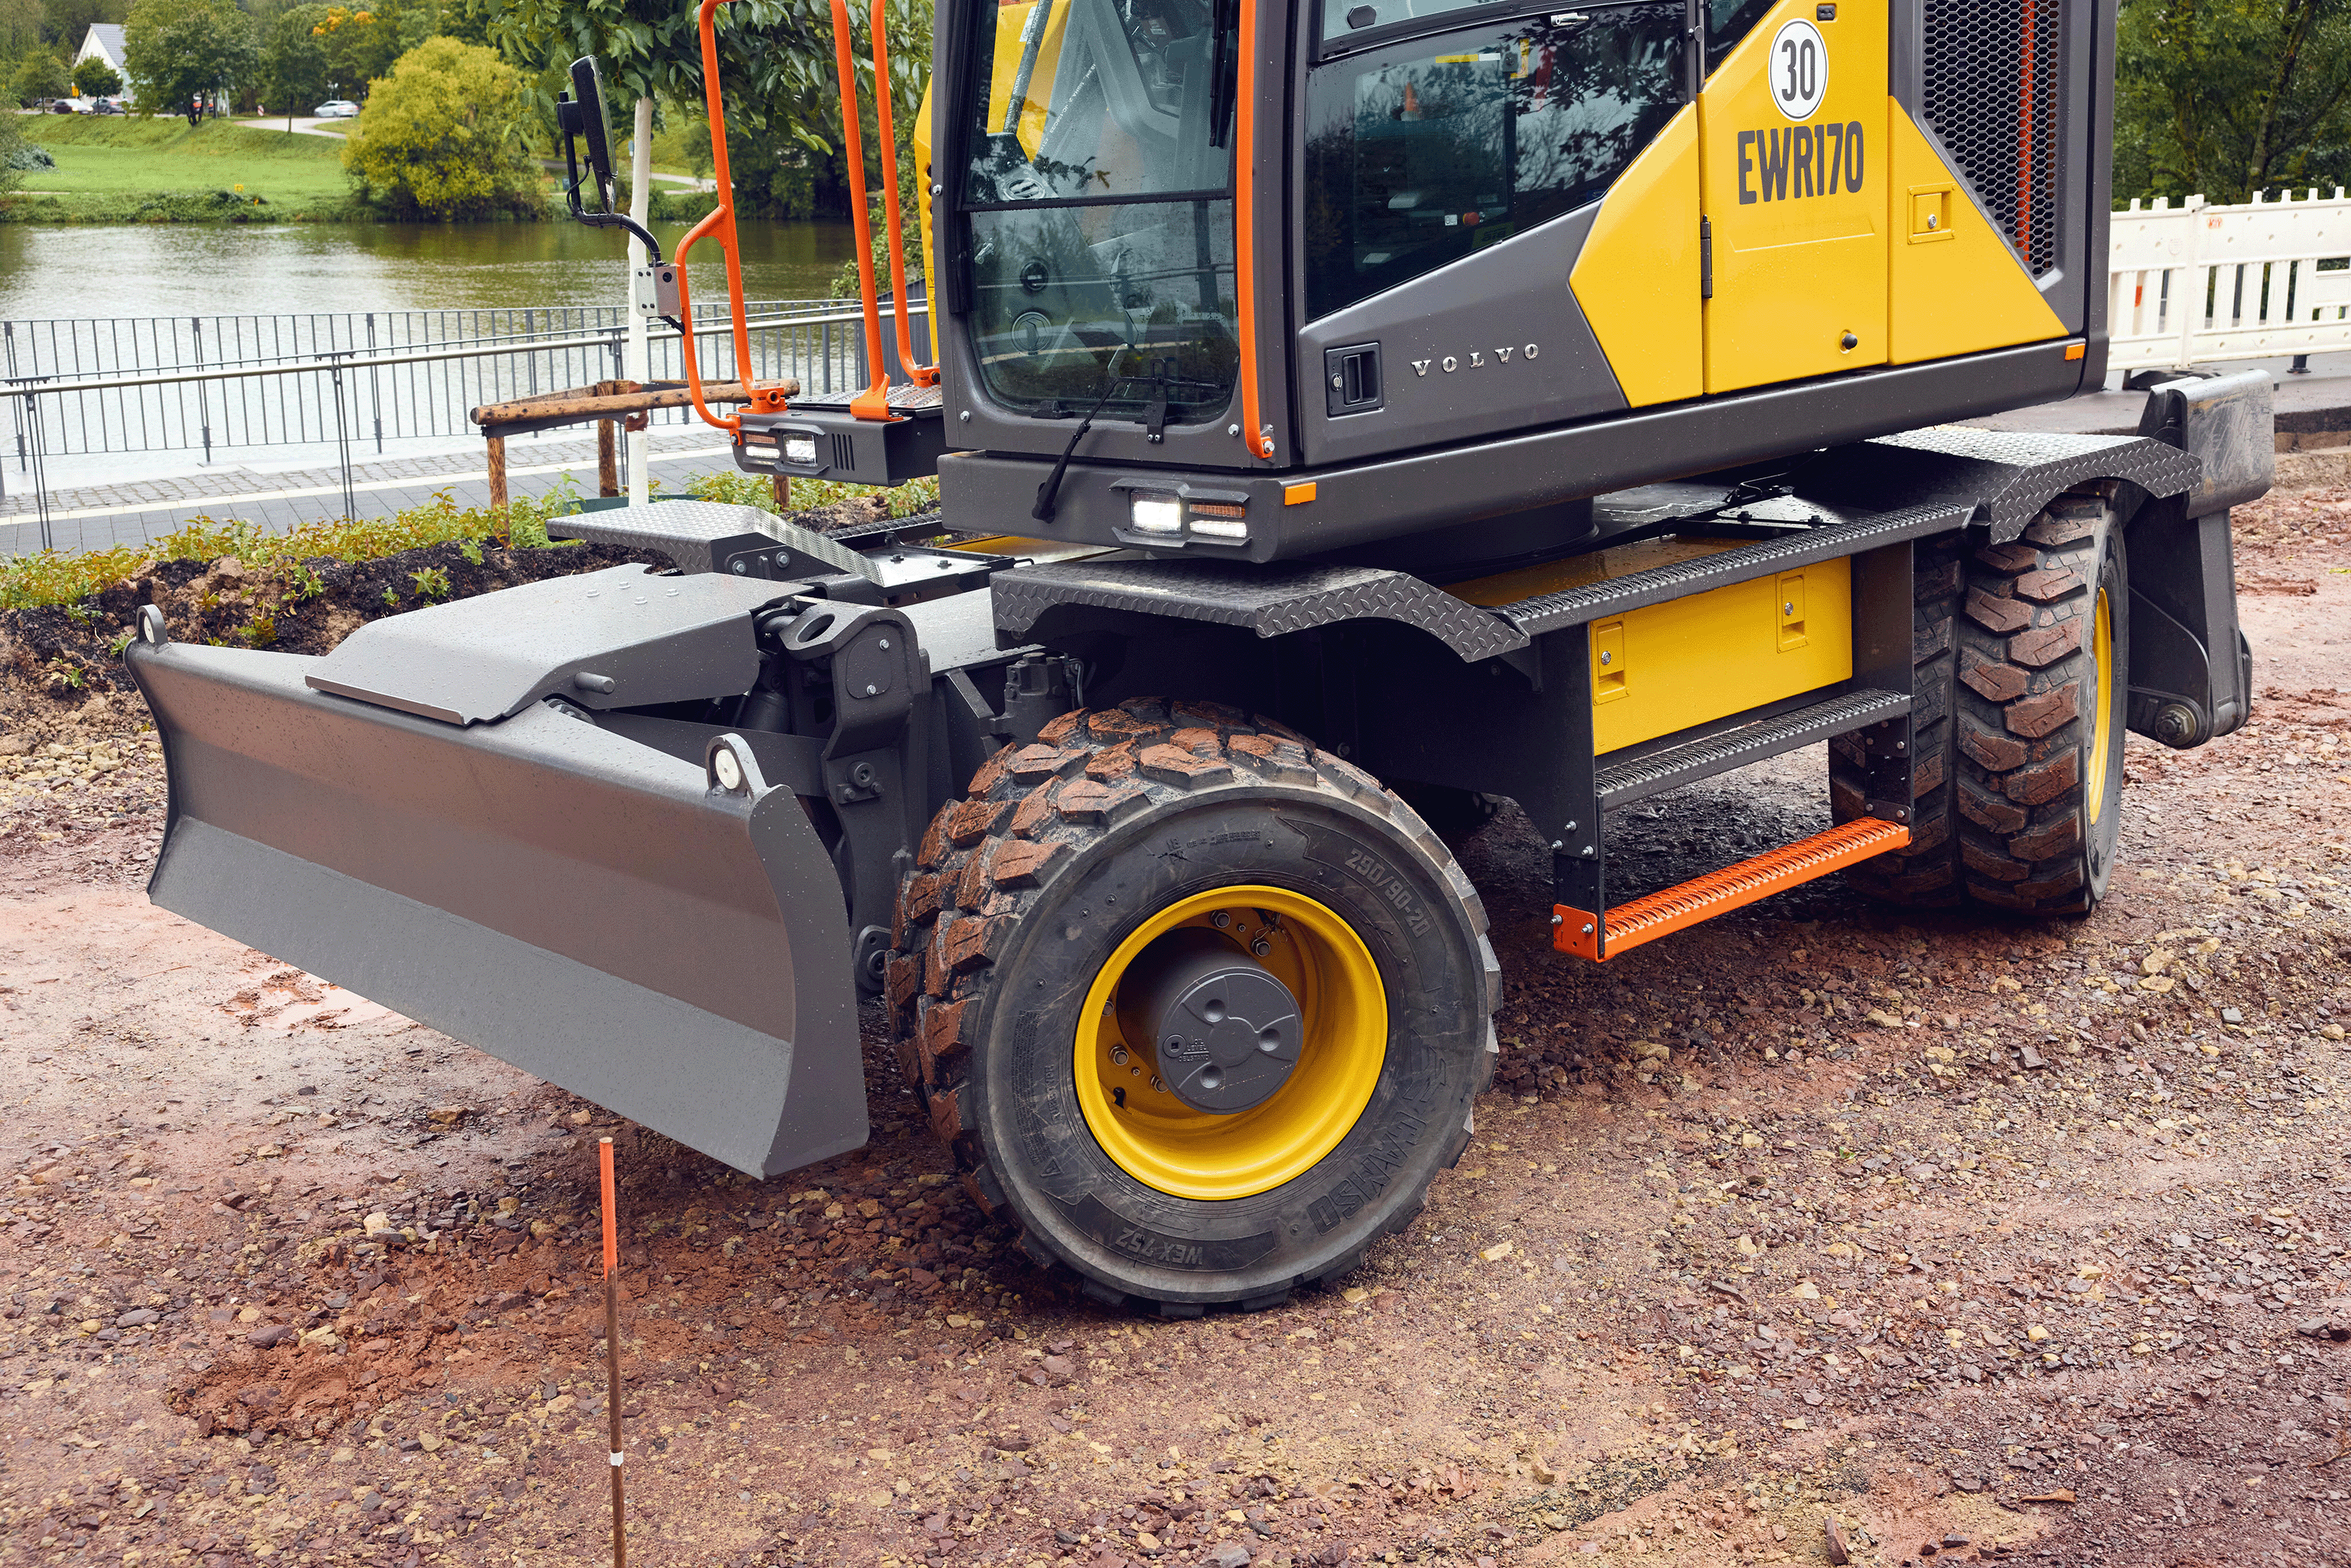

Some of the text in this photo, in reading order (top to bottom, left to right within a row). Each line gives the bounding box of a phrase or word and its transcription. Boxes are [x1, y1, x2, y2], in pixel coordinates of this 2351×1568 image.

[1781, 38, 1816, 102] 30
[1737, 121, 1864, 205] EWR170
[1411, 343, 1539, 377] VOLVO
[1344, 847, 1431, 938] 290/90-20
[1179, 1054, 1209, 1063] OELSTAND
[1306, 1111, 1427, 1236] CAMSO
[1115, 1227, 1203, 1265] WEX 752
